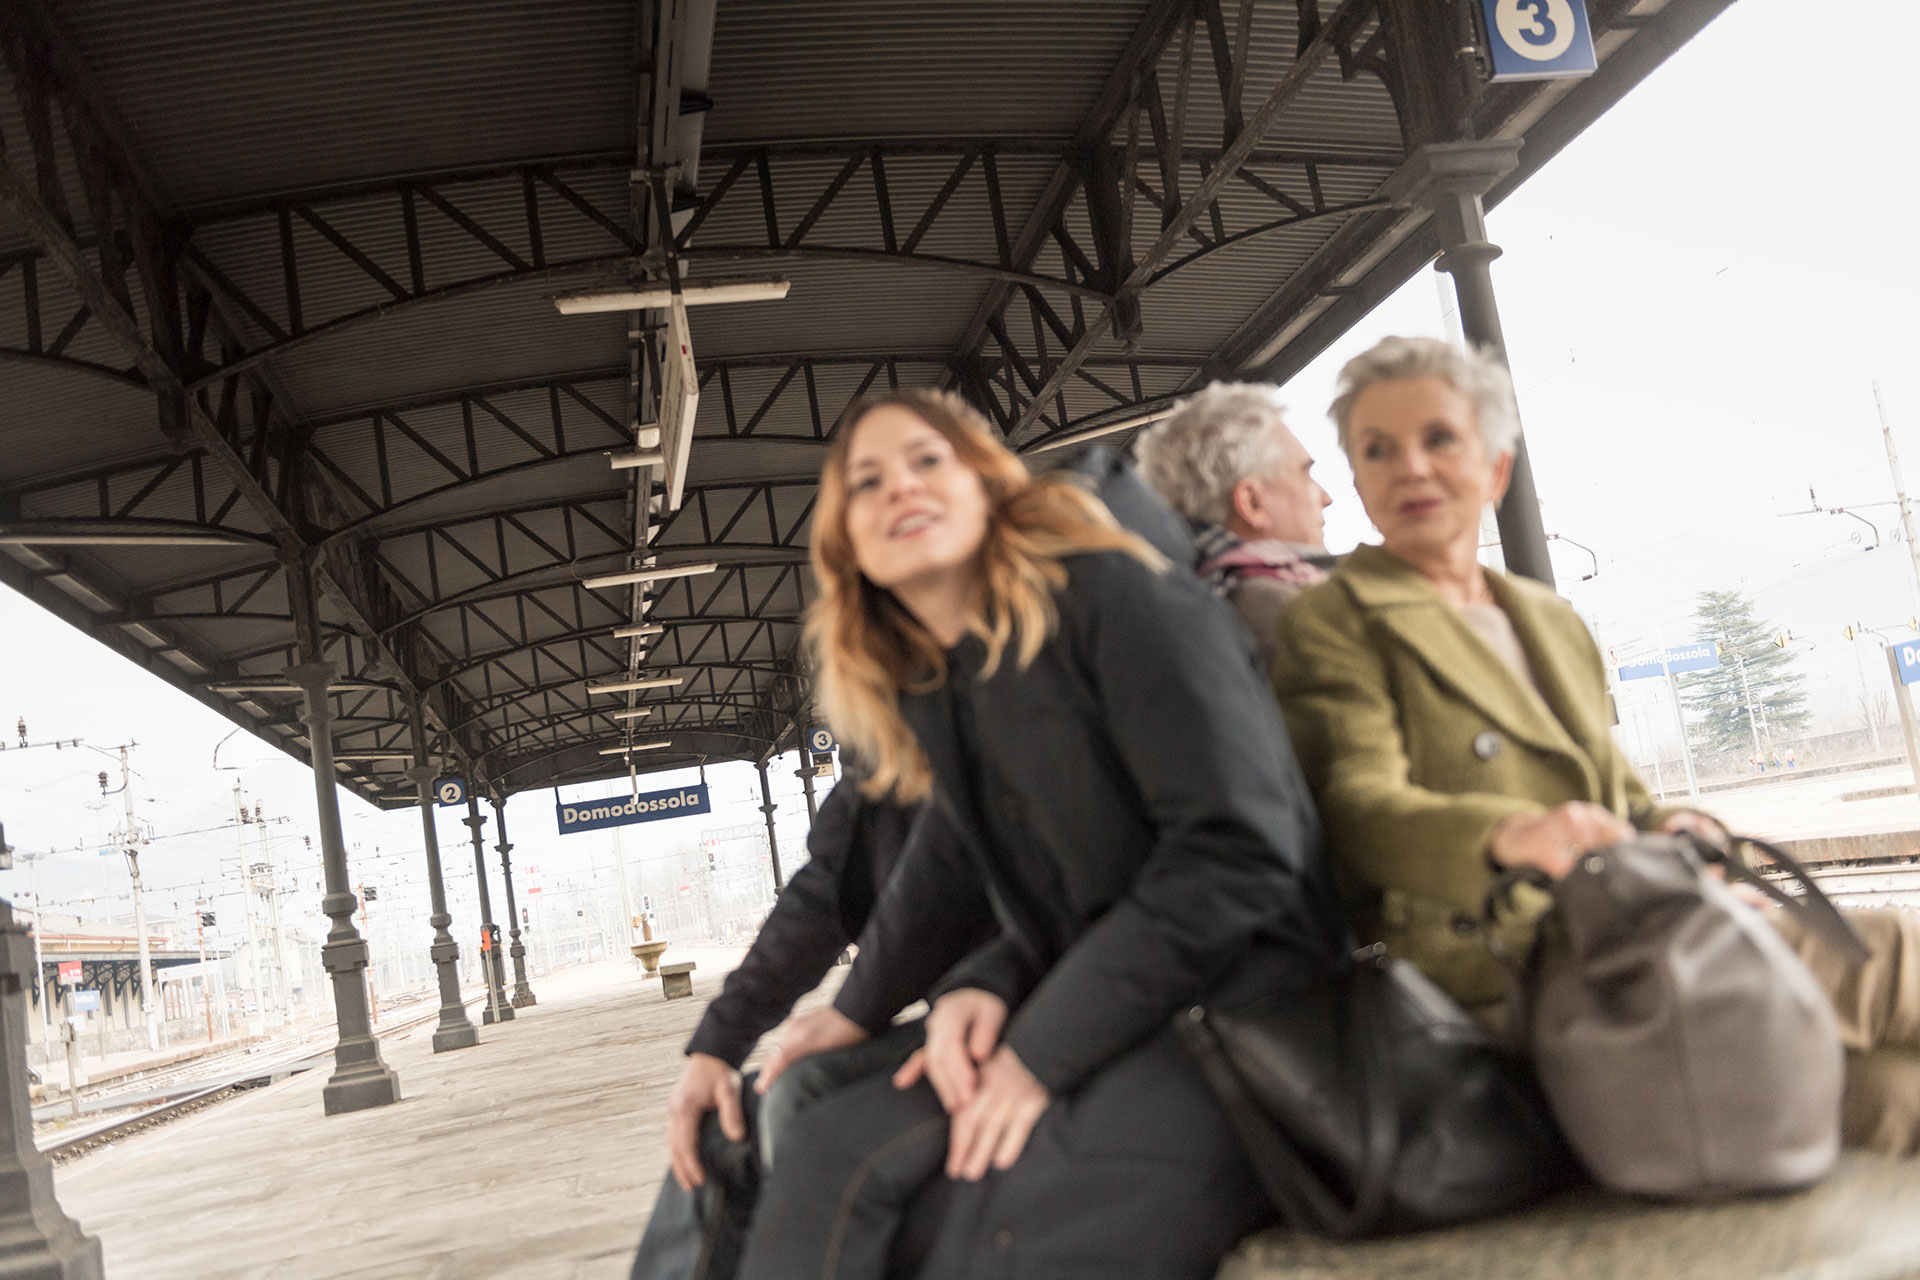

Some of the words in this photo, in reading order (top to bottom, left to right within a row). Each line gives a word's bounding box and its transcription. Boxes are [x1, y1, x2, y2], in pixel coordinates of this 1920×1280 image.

[1516, 0, 1557, 46] 3
[818, 734, 828, 746] 3
[445, 786, 457, 800] 2
[563, 790, 699, 824] Domodossola
